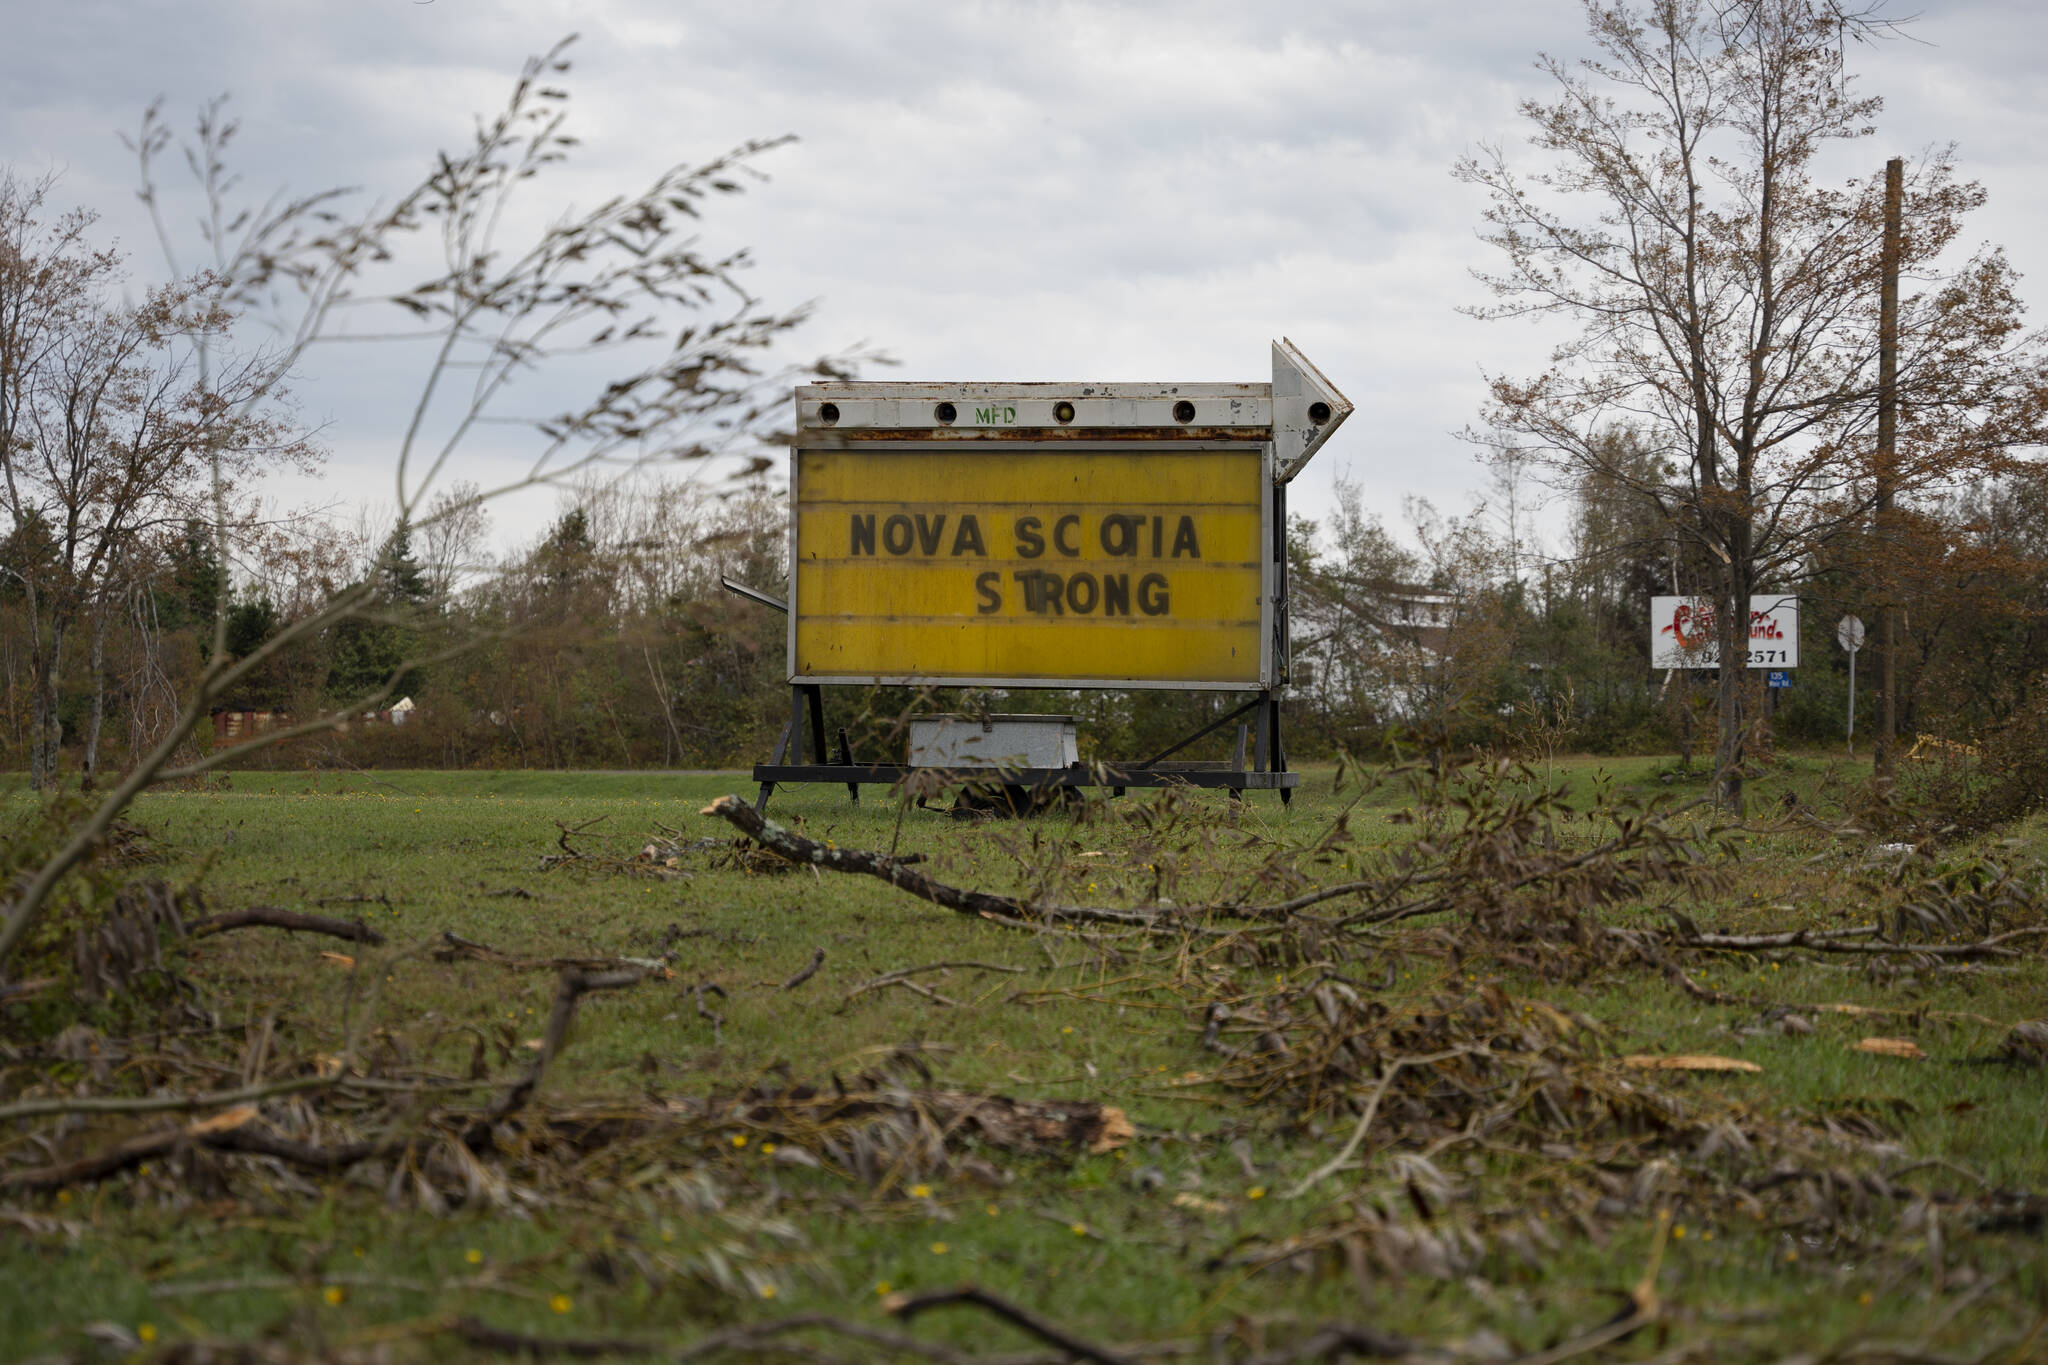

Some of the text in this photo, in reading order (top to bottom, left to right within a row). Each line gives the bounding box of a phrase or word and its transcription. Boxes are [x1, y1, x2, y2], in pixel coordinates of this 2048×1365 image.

[975, 406, 1017, 425] MFD
[851, 513, 1201, 560] NOVA SCOTIA
[975, 569, 1171, 617] STRONG
